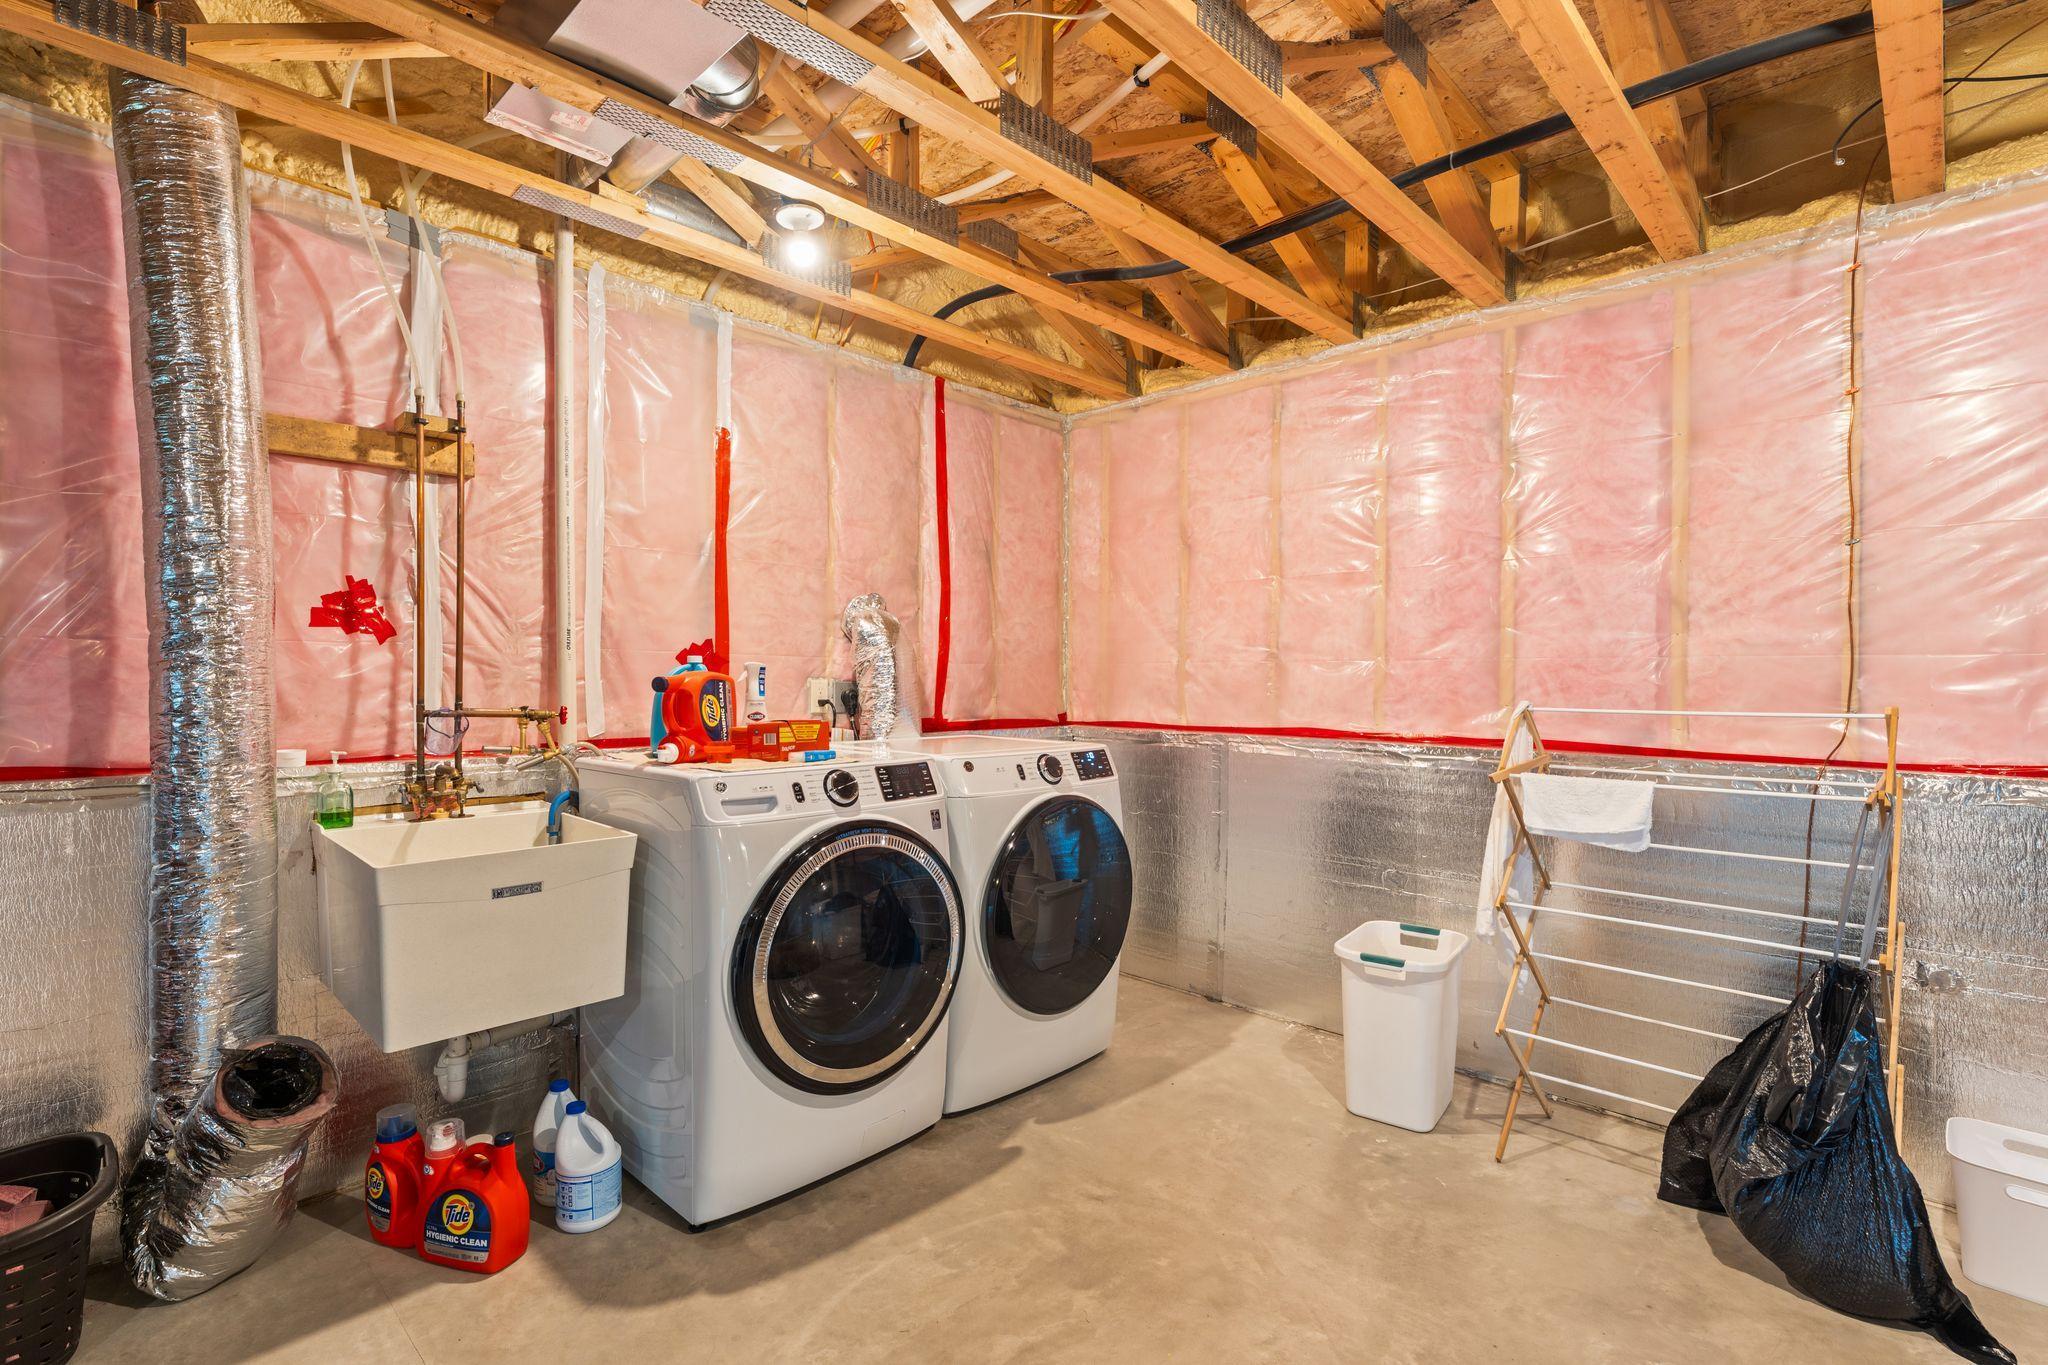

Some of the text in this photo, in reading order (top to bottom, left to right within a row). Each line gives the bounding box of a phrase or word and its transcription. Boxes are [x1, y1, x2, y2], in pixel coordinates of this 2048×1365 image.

[718, 682, 726, 707] CLEAN
[706, 698, 719, 723] Tide
[367, 1173, 382, 1190] Tide
[378, 1205, 390, 1214] CLEAN
[445, 1203, 471, 1227] Tide
[426, 1230, 459, 1243] HYGIENIC
[459, 1238, 488, 1248] CLEAN
